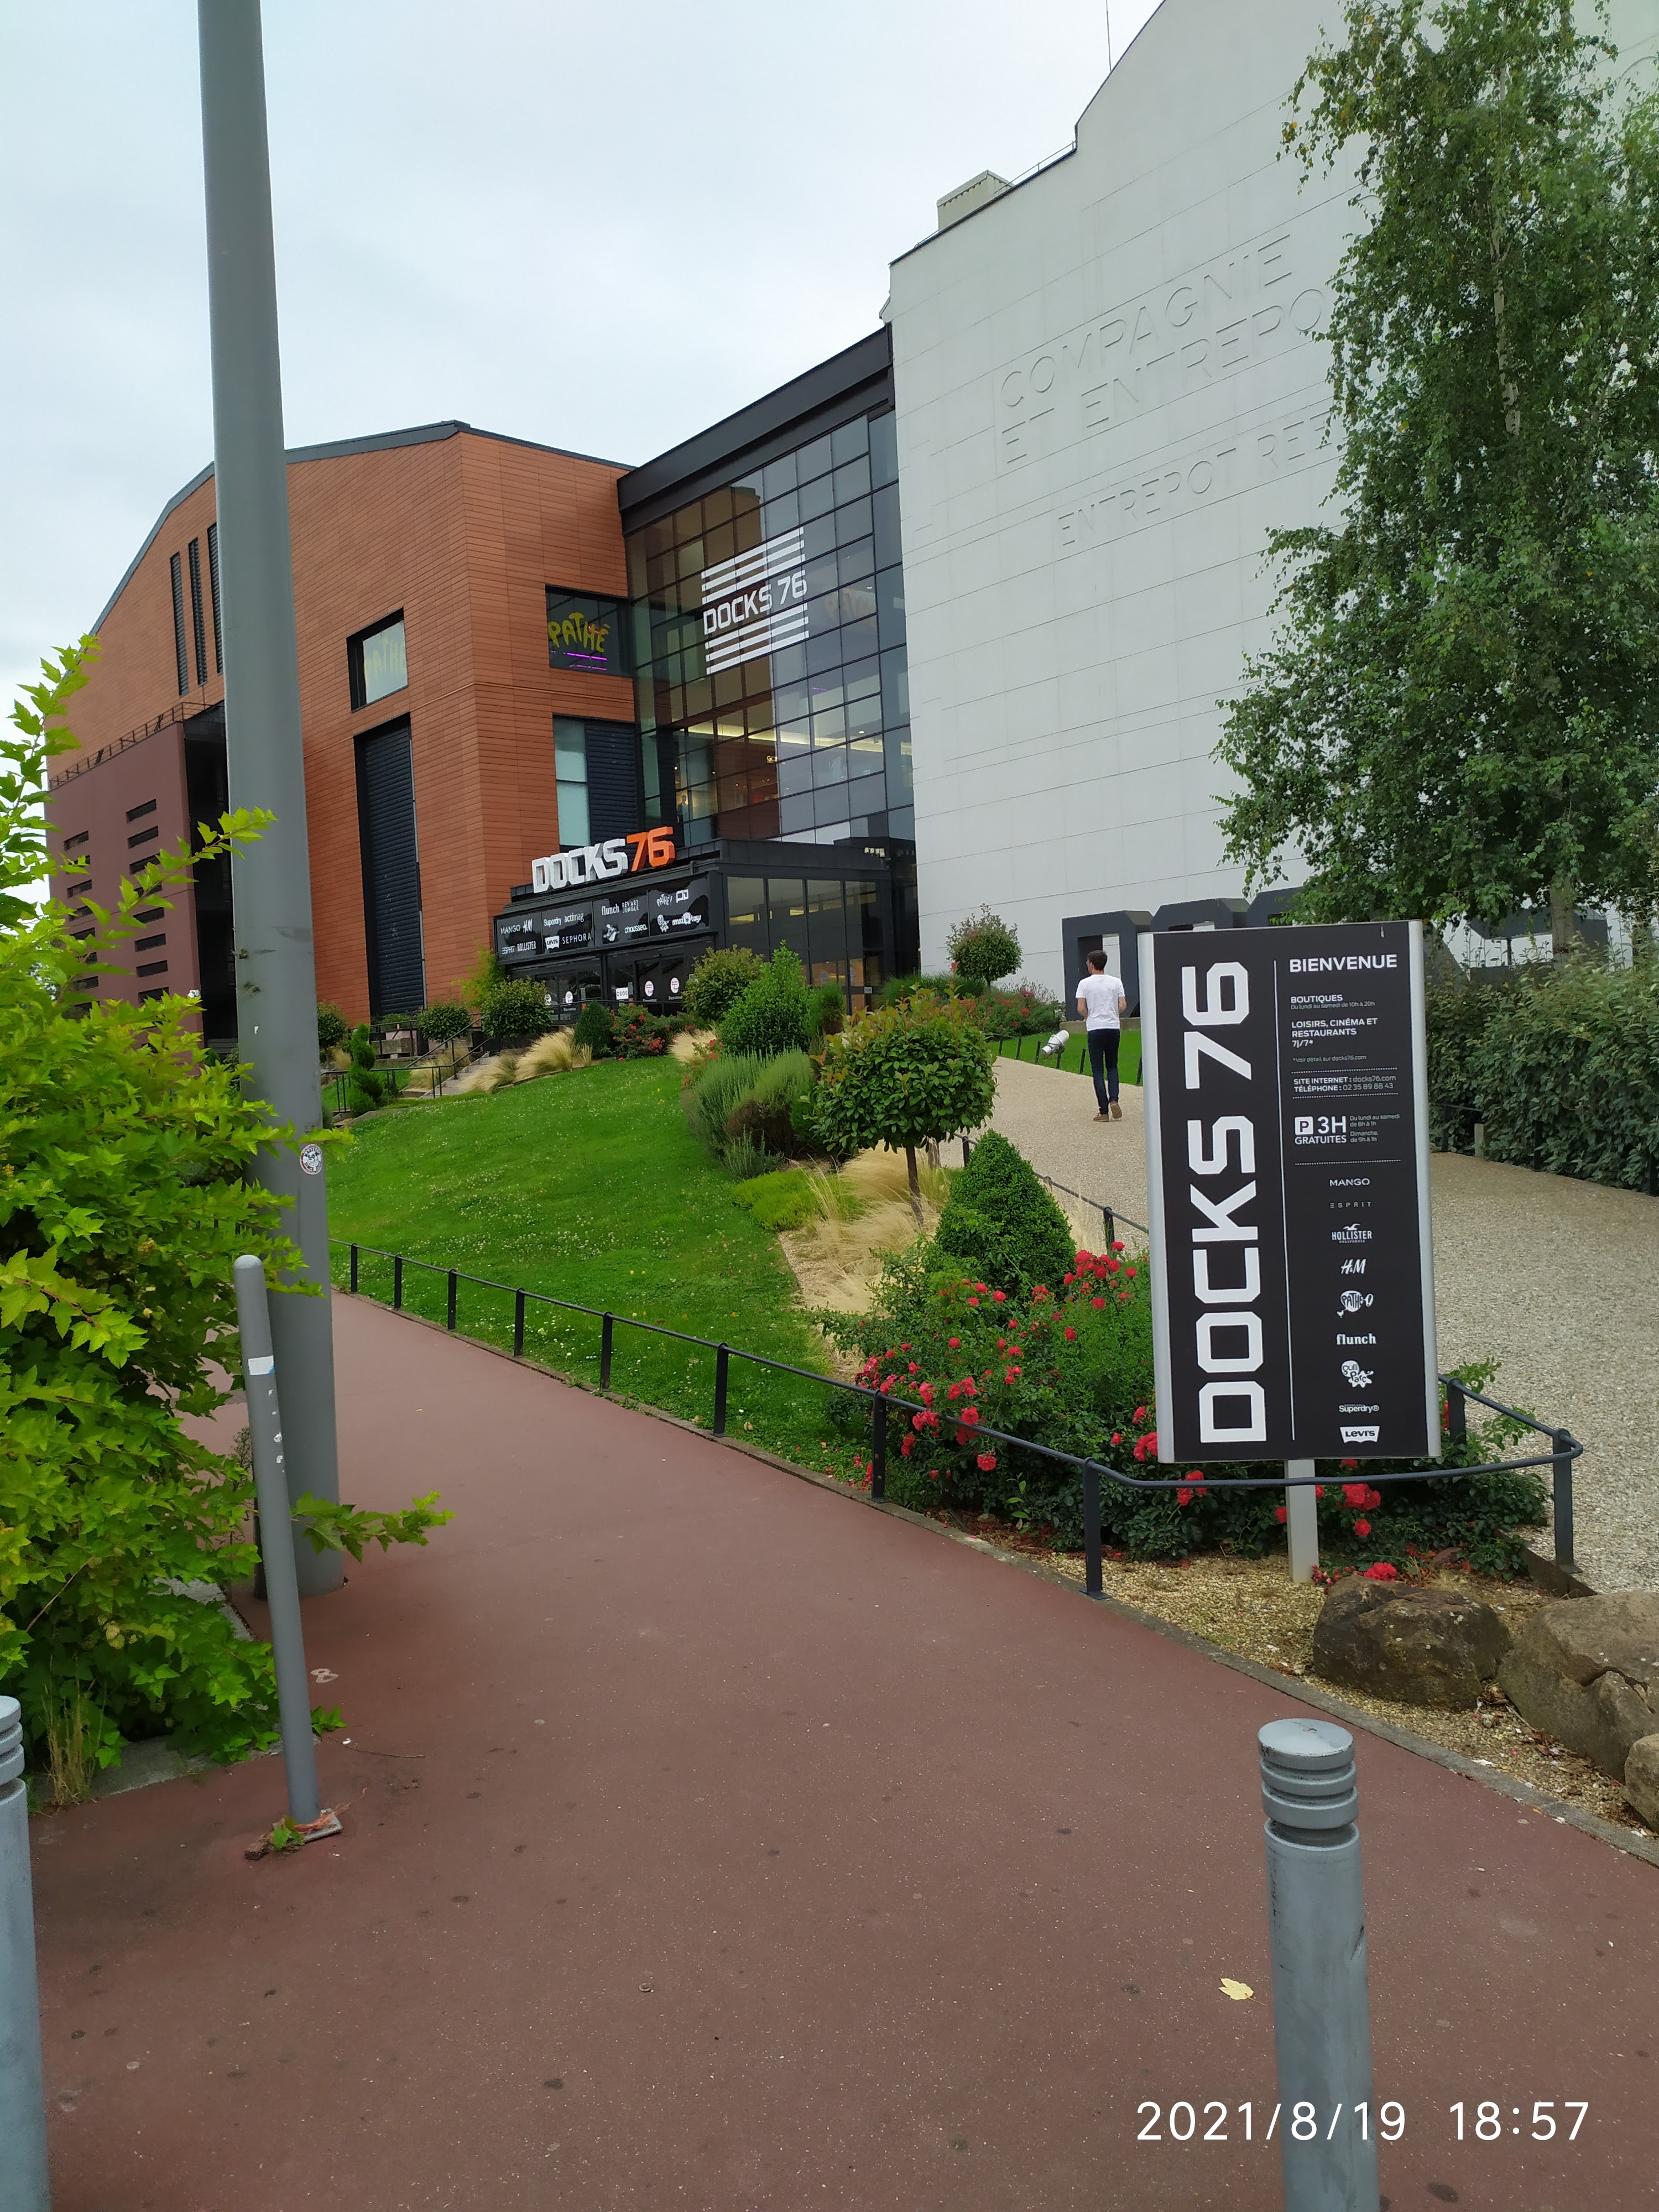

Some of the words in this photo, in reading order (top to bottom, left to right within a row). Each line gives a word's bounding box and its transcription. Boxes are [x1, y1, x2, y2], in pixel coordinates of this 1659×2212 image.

[1001, 234, 1292, 407] COMPAGNIE
[1001, 408, 1055, 467] ET
[1081, 289, 1326, 431] ENTREPO
[1058, 447, 1237, 546] ENTREPOT
[703, 583, 773, 635] DOCKS
[777, 569, 807, 605] 76
[531, 838, 629, 894] DOCKS
[626, 826, 676, 872] 76
[601, 903, 620, 916] flunch
[622, 905, 639, 914] JUNGLE
[544, 917, 562, 927] Superdry
[564, 912, 585, 923] actimag
[500, 924, 521, 935] MANGO
[562, 933, 592, 945] SEPHORA
[501, 945, 515, 955] ESPRIT
[517, 941, 536, 952] HOLLISTER
[1290, 954, 1397, 973] BIENVENUE
[1291, 995, 1343, 1004] BOUTIQUES
[1181, 962, 1252, 1089] 76
[1291, 1020, 1329, 1029] LOISIRS,
[1329, 1018, 1365, 1026] CINÉMA
[1292, 1028, 1357, 1038] RESTAURANTS
[1294, 1084, 1338, 1093] TÉLÉPHONE
[1295, 1135, 1347, 1145] GRATUITES
[1329, 1178, 1370, 1187] MANGO
[1332, 1230, 1372, 1240] HOLLISTER
[1340, 1259, 1366, 1275] H&M
[1187, 1115, 1267, 1443] DOCKS
[1336, 1333, 1377, 1345] flunch
[1342, 1363, 1358, 1375] gulli
[1350, 1371, 1366, 1383] Parc
